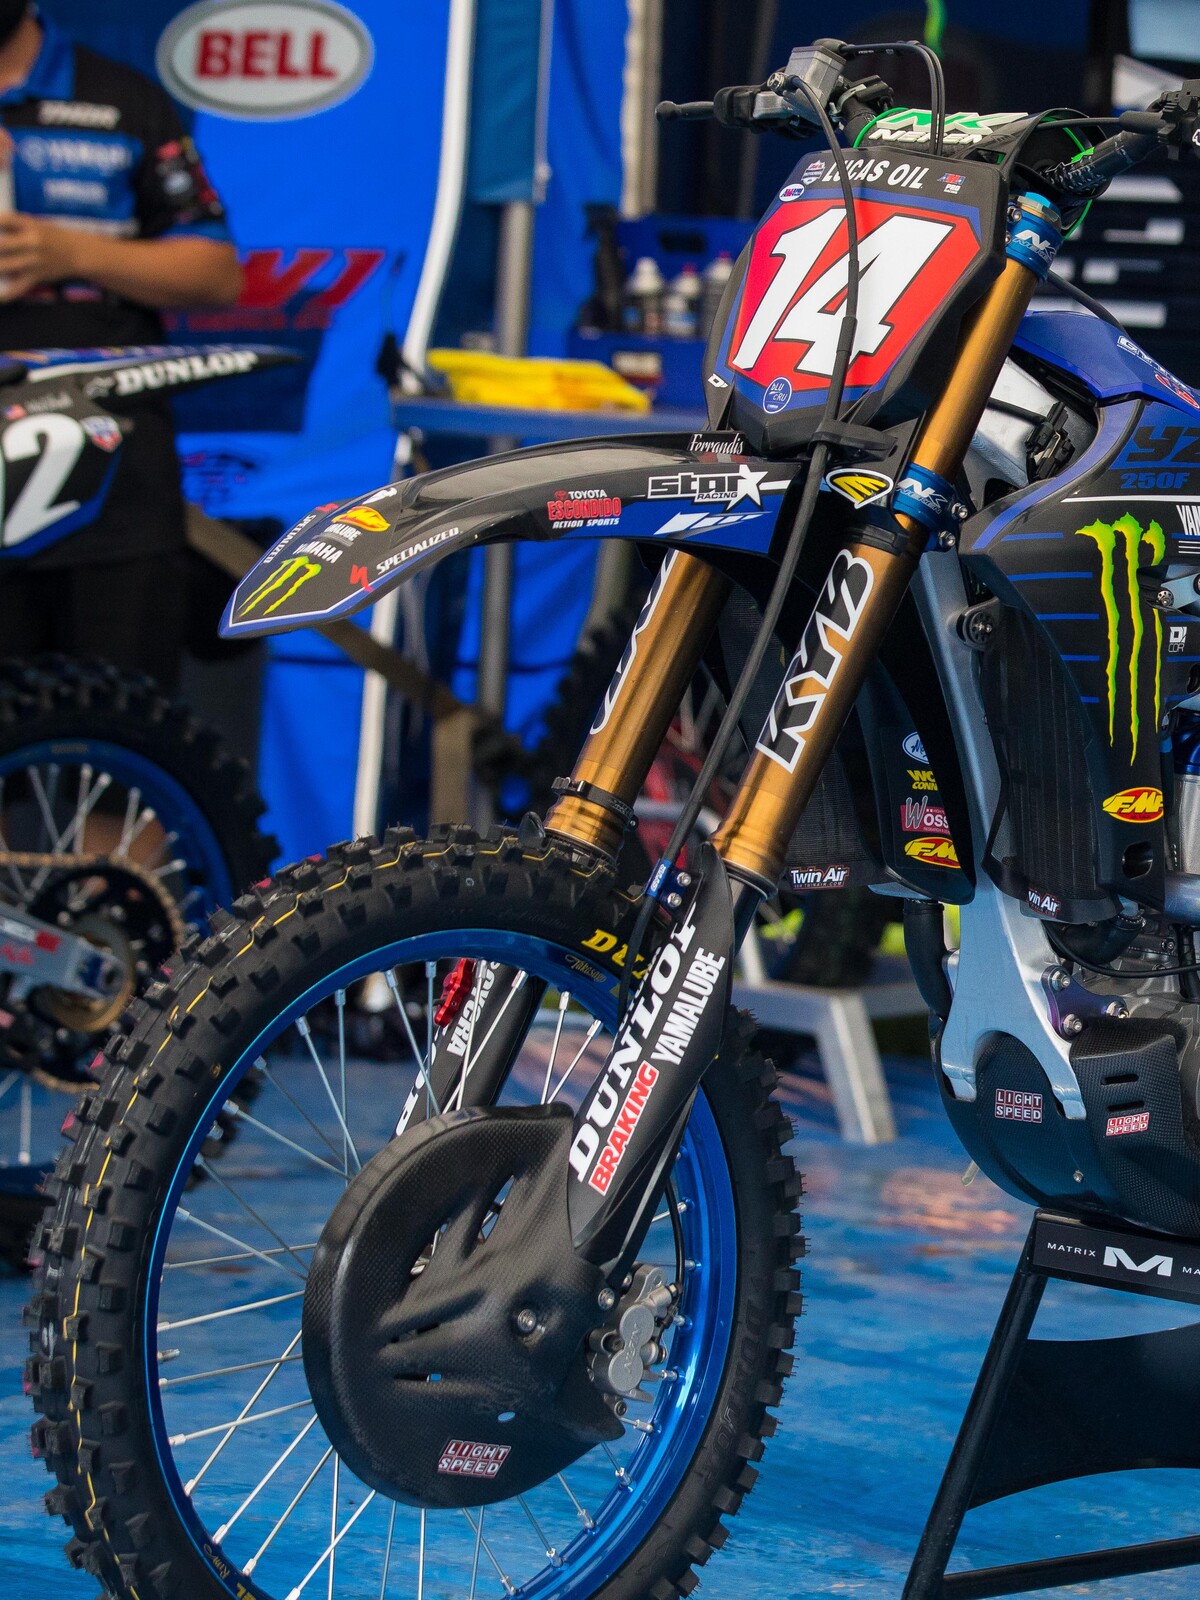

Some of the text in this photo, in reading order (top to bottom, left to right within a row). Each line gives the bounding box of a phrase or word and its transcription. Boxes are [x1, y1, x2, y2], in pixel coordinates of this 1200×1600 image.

[196, 31, 338, 80] BELL
[887, 163, 930, 190] OIL
[733, 208, 955, 376] 14
[113, 351, 259, 396] DUNLOP
[690, 432, 744, 454] Ferrandis
[648, 471, 744, 500] star
[1121, 473, 1190, 489] 250F
[568, 489, 607, 500] TOYOTA
[697, 491, 738, 501] RACING
[547, 498, 622, 521] ESCONDIDO
[552, 517, 620, 530] ACTION SPORTS
[376, 527, 460, 576] SPECIALIZED
[755, 549, 874, 774] KYB
[1103, 791, 1163, 813] FMF
[905, 841, 959, 863] FM
[791, 866, 848, 884] Twin Air
[1041, 896, 1059, 912] Air
[651, 947, 726, 1066] YAMALUBE
[997, 1091, 1041, 1106] LIGHT
[996, 1106, 1041, 1121] SPEED
[1108, 1113, 1149, 1127] LIGHT
[589, 1060, 660, 1196] BRAKING
[1107, 1122, 1148, 1135] SPEED
[1047, 1242, 1096, 1257] MATRIX
[447, 1441, 508, 1460] LIGHT
[438, 1458, 501, 1477] SPEED
